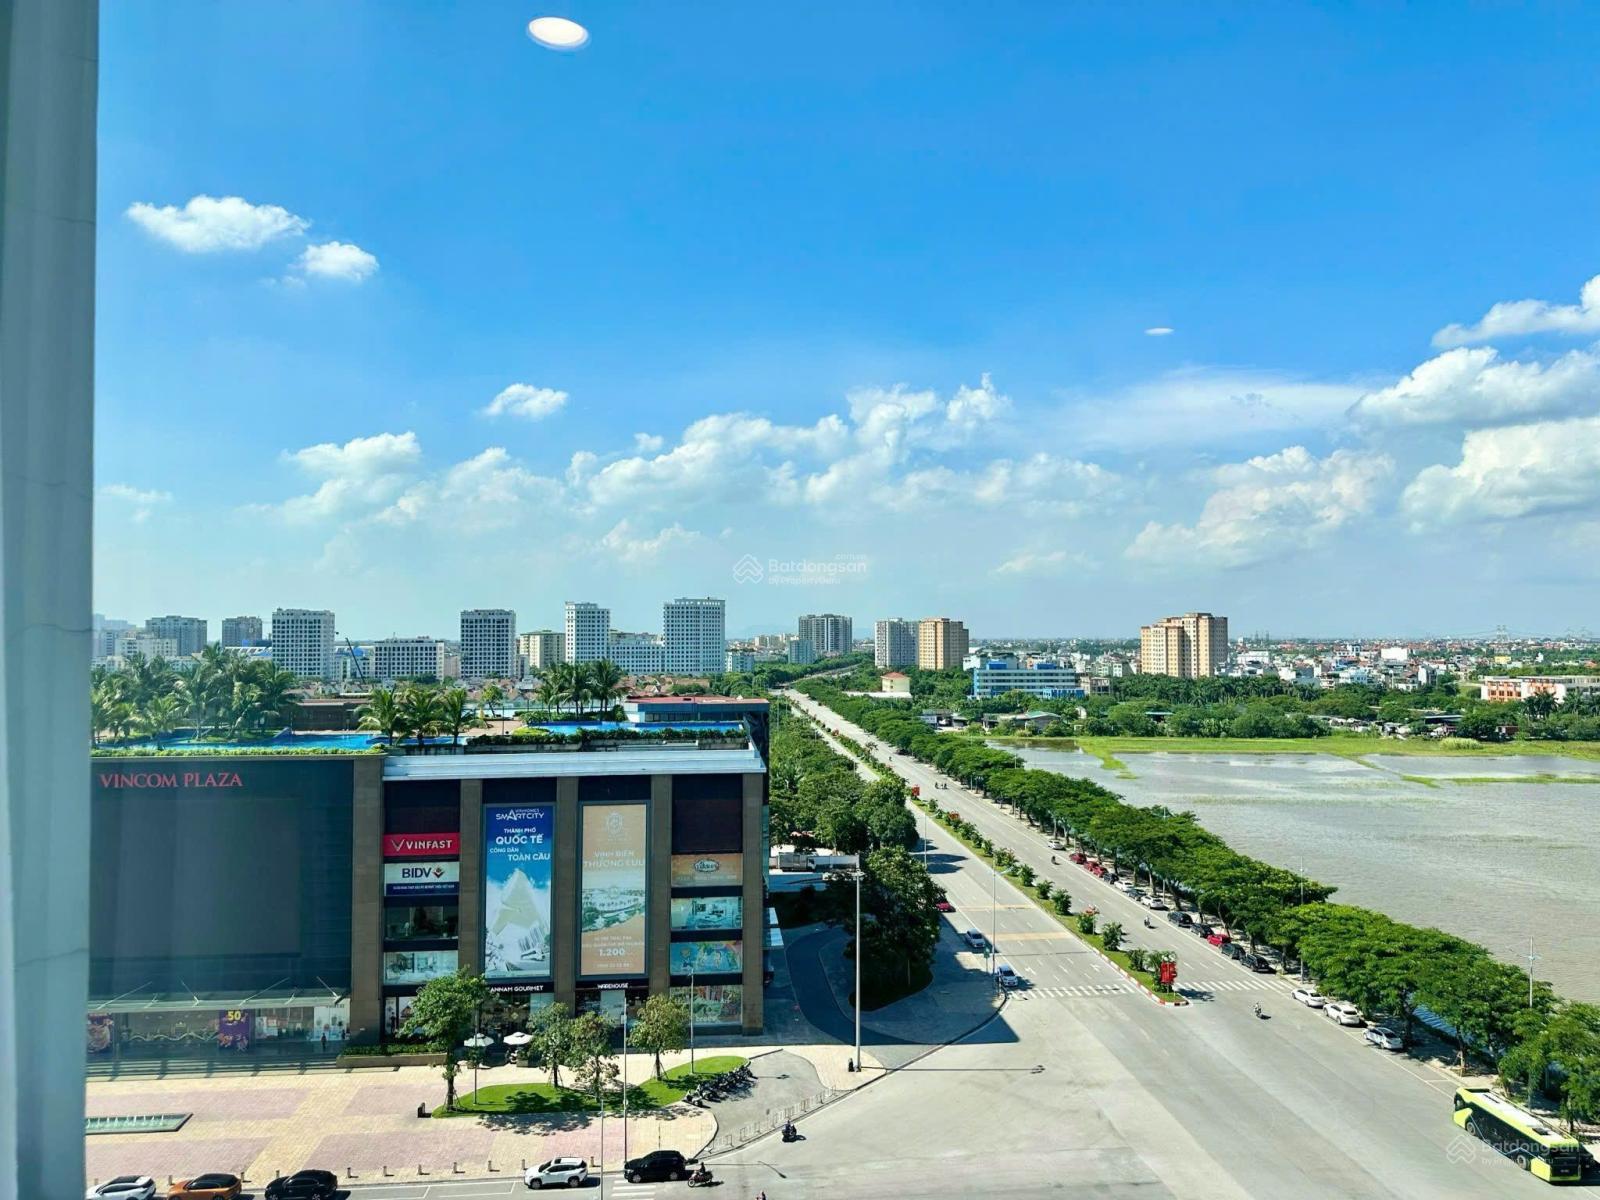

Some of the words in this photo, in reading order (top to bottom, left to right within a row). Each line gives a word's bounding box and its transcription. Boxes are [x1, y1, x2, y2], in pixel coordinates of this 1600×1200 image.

[99, 773, 179, 788] VINCOM
[183, 772, 243, 787] PLAZA
[495, 834, 528, 845] QUỐC
[530, 833, 544, 844] TẾ
[406, 840, 453, 850] VINFAST
[508, 853, 531, 861] TOÀN
[532, 852, 551, 860] CẦU
[402, 868, 432, 878] BIDV
